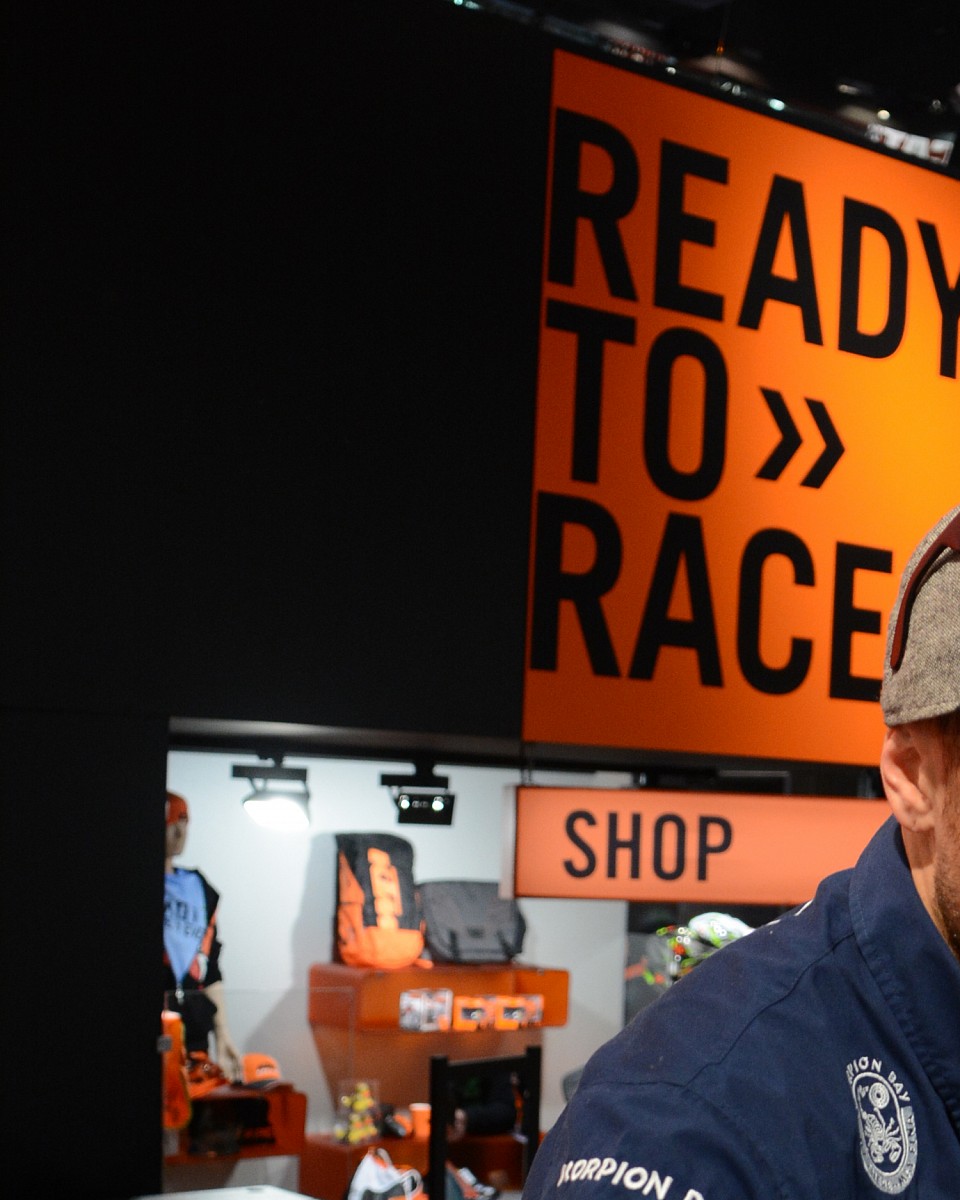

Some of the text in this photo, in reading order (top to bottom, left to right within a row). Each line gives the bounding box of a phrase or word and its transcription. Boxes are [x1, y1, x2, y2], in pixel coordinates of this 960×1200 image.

[545, 307, 730, 502] TO
[529, 490, 894, 703] RACE
[563, 810, 733, 881] SHOP
